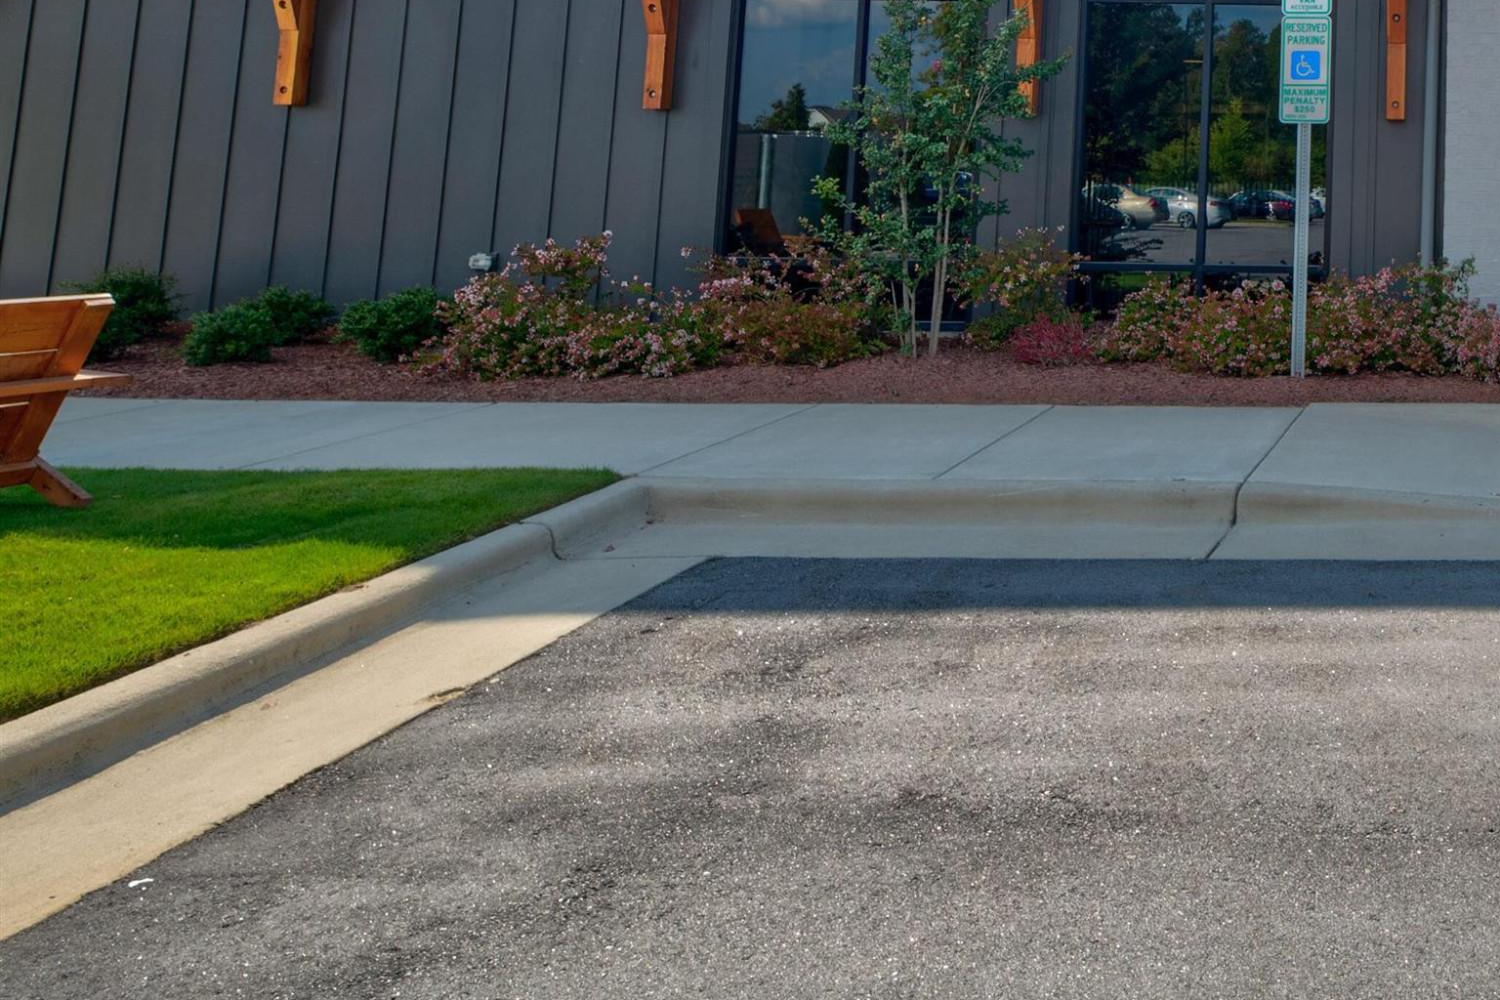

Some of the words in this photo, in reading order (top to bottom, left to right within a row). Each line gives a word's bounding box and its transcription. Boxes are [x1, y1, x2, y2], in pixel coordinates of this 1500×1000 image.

[1285, 23, 1327, 32] RESERVED
[1287, 35, 1325, 45] PARKING
[1283, 88, 1327, 96] MAXIMUM
[1283, 96, 1325, 105] PENALTY
[1294, 105, 1316, 113] $250
